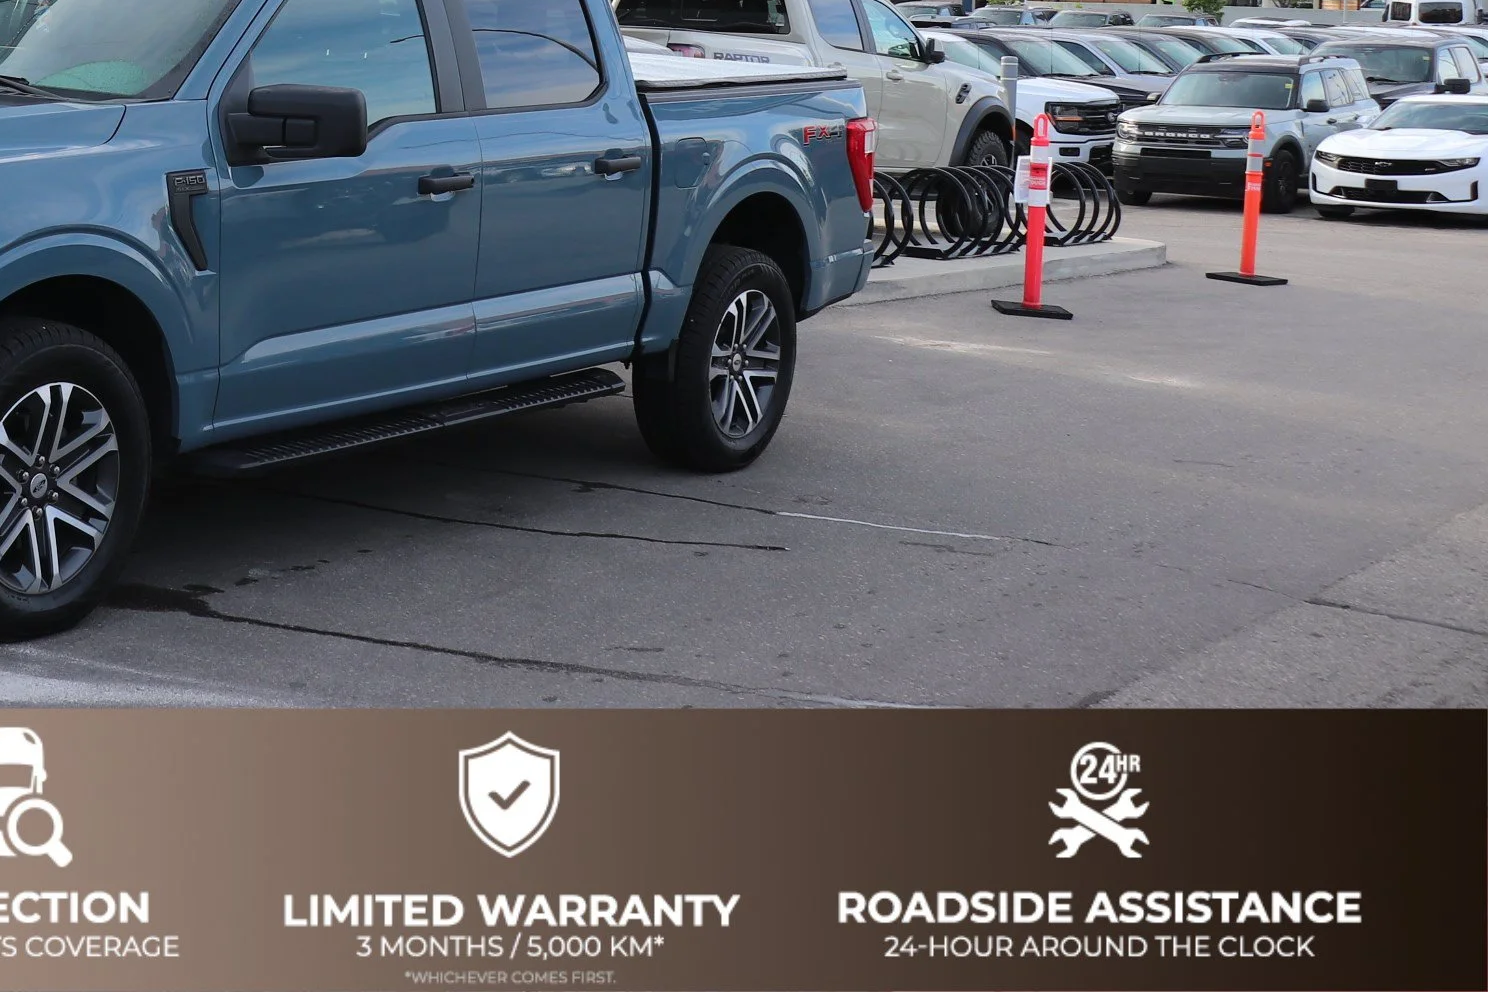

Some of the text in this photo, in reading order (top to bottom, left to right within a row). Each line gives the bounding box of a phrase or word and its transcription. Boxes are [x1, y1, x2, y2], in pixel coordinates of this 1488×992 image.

[713, 52, 770, 64] RAPTOR
[802, 124, 843, 147] FX4
[1144, 131, 1211, 139] BRONCO
[174, 175, 205, 186] F-150
